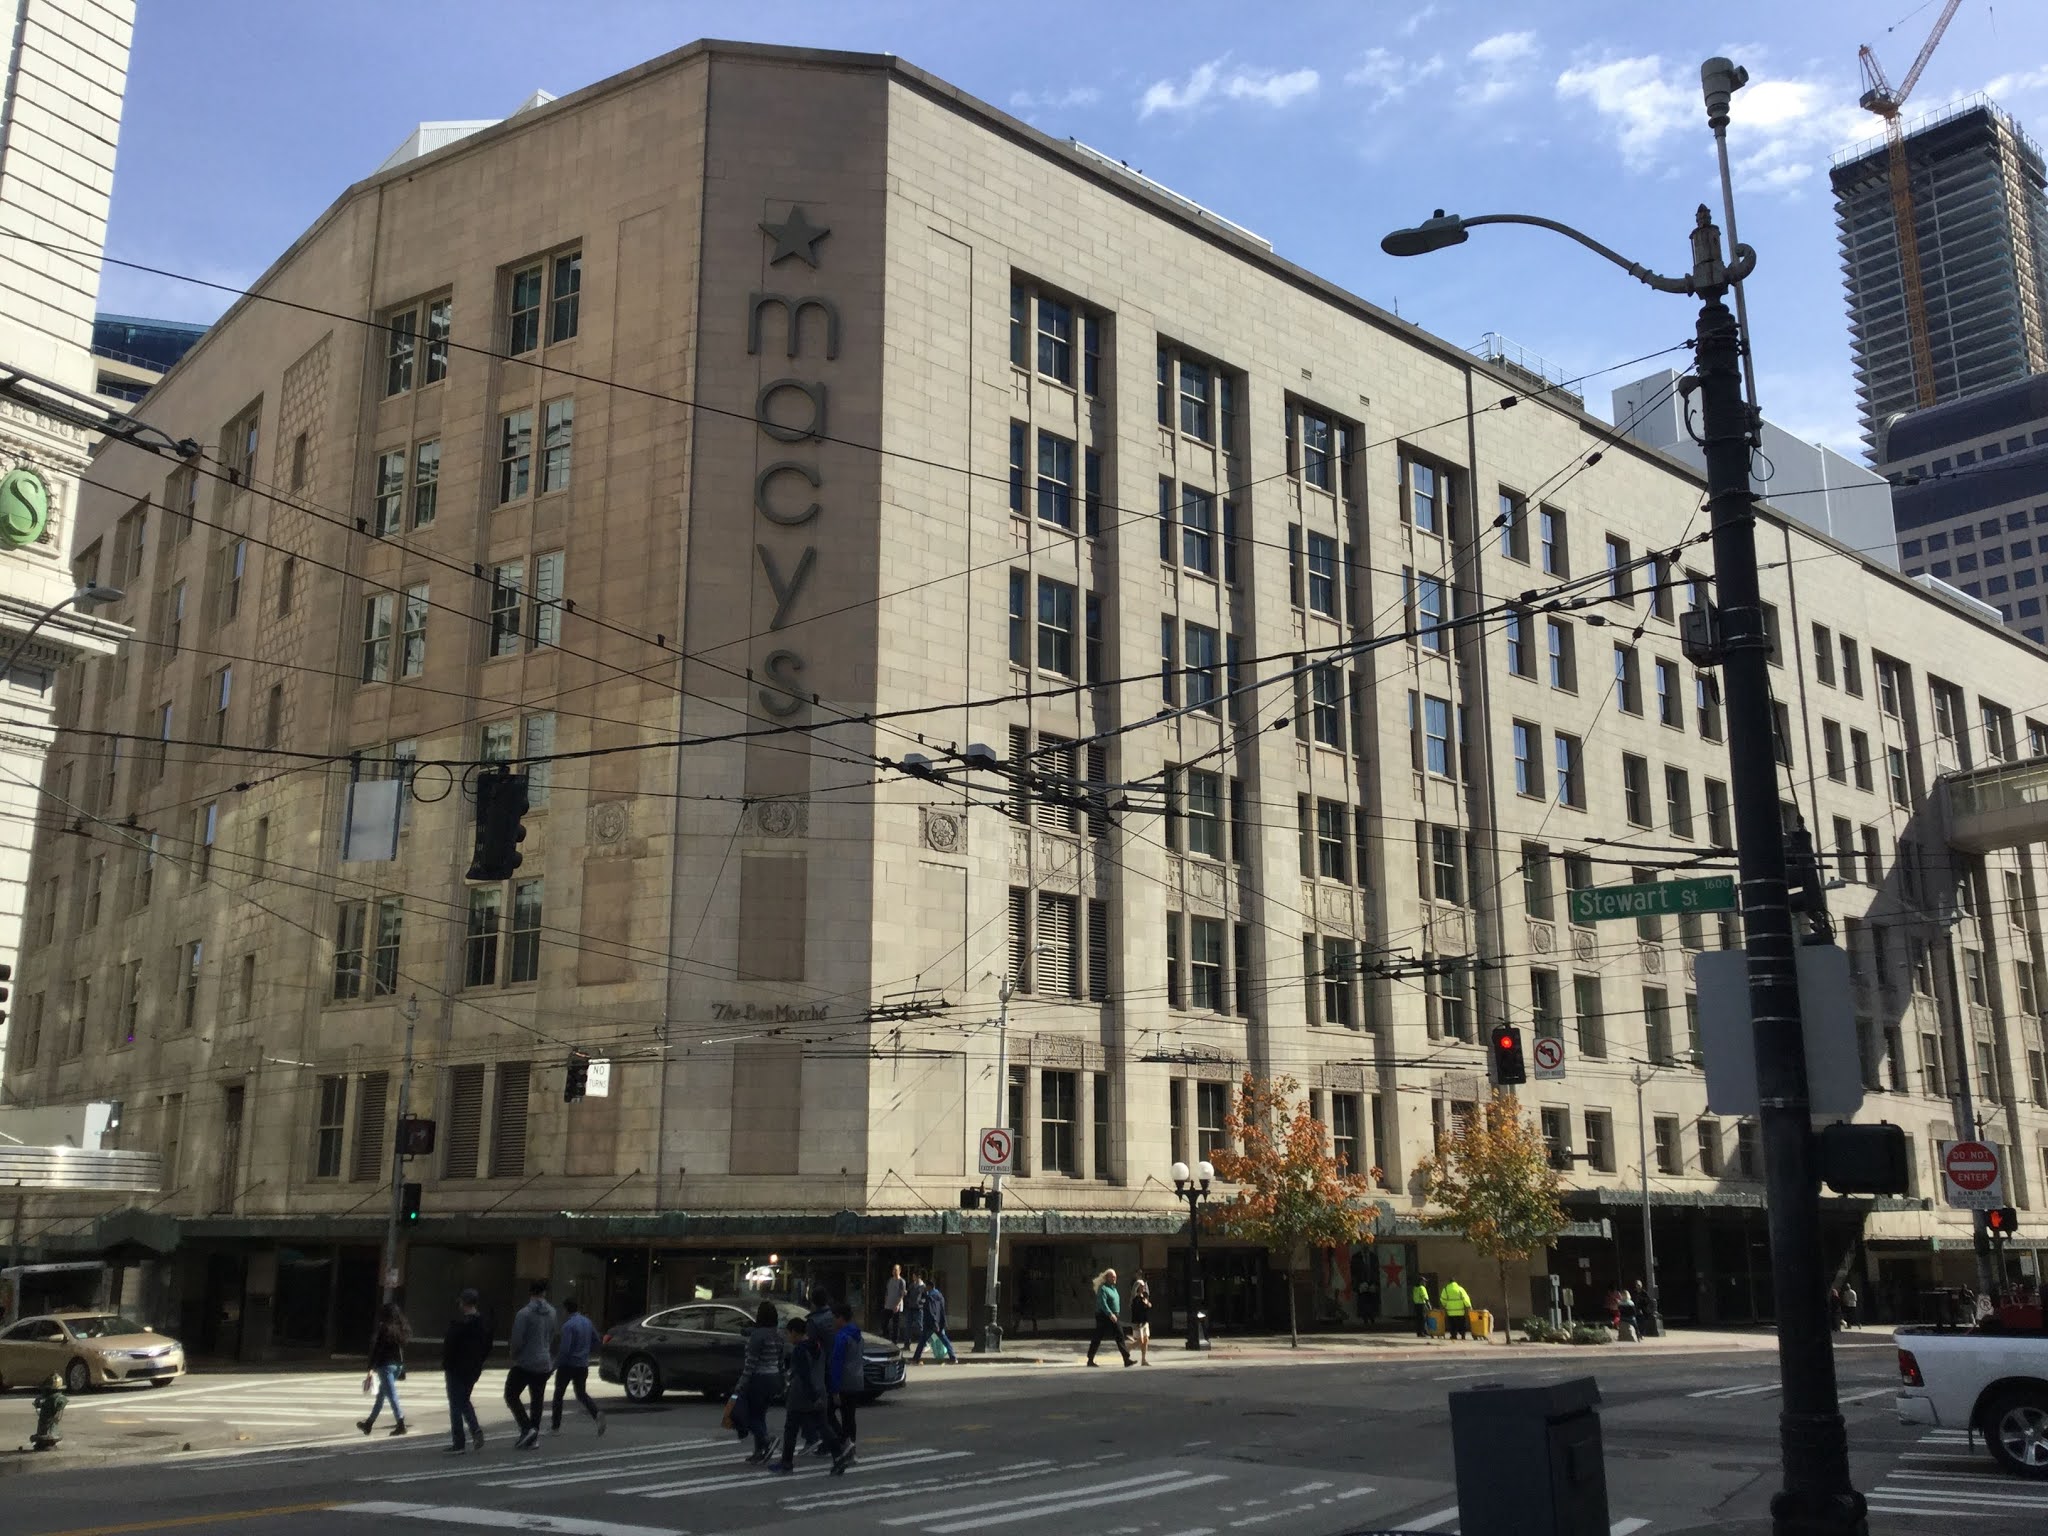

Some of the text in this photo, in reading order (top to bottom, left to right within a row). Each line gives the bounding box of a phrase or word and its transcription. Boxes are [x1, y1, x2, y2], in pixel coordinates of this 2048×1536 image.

[1704, 877, 1730, 890] 1600
[1579, 885, 1699, 916] Stewart St
[712, 1003, 741, 1020] The
[593, 1065, 605, 1075] NO
[1952, 1151, 1990, 1160] DO NOT
[1957, 1173, 1989, 1181] ENTER
